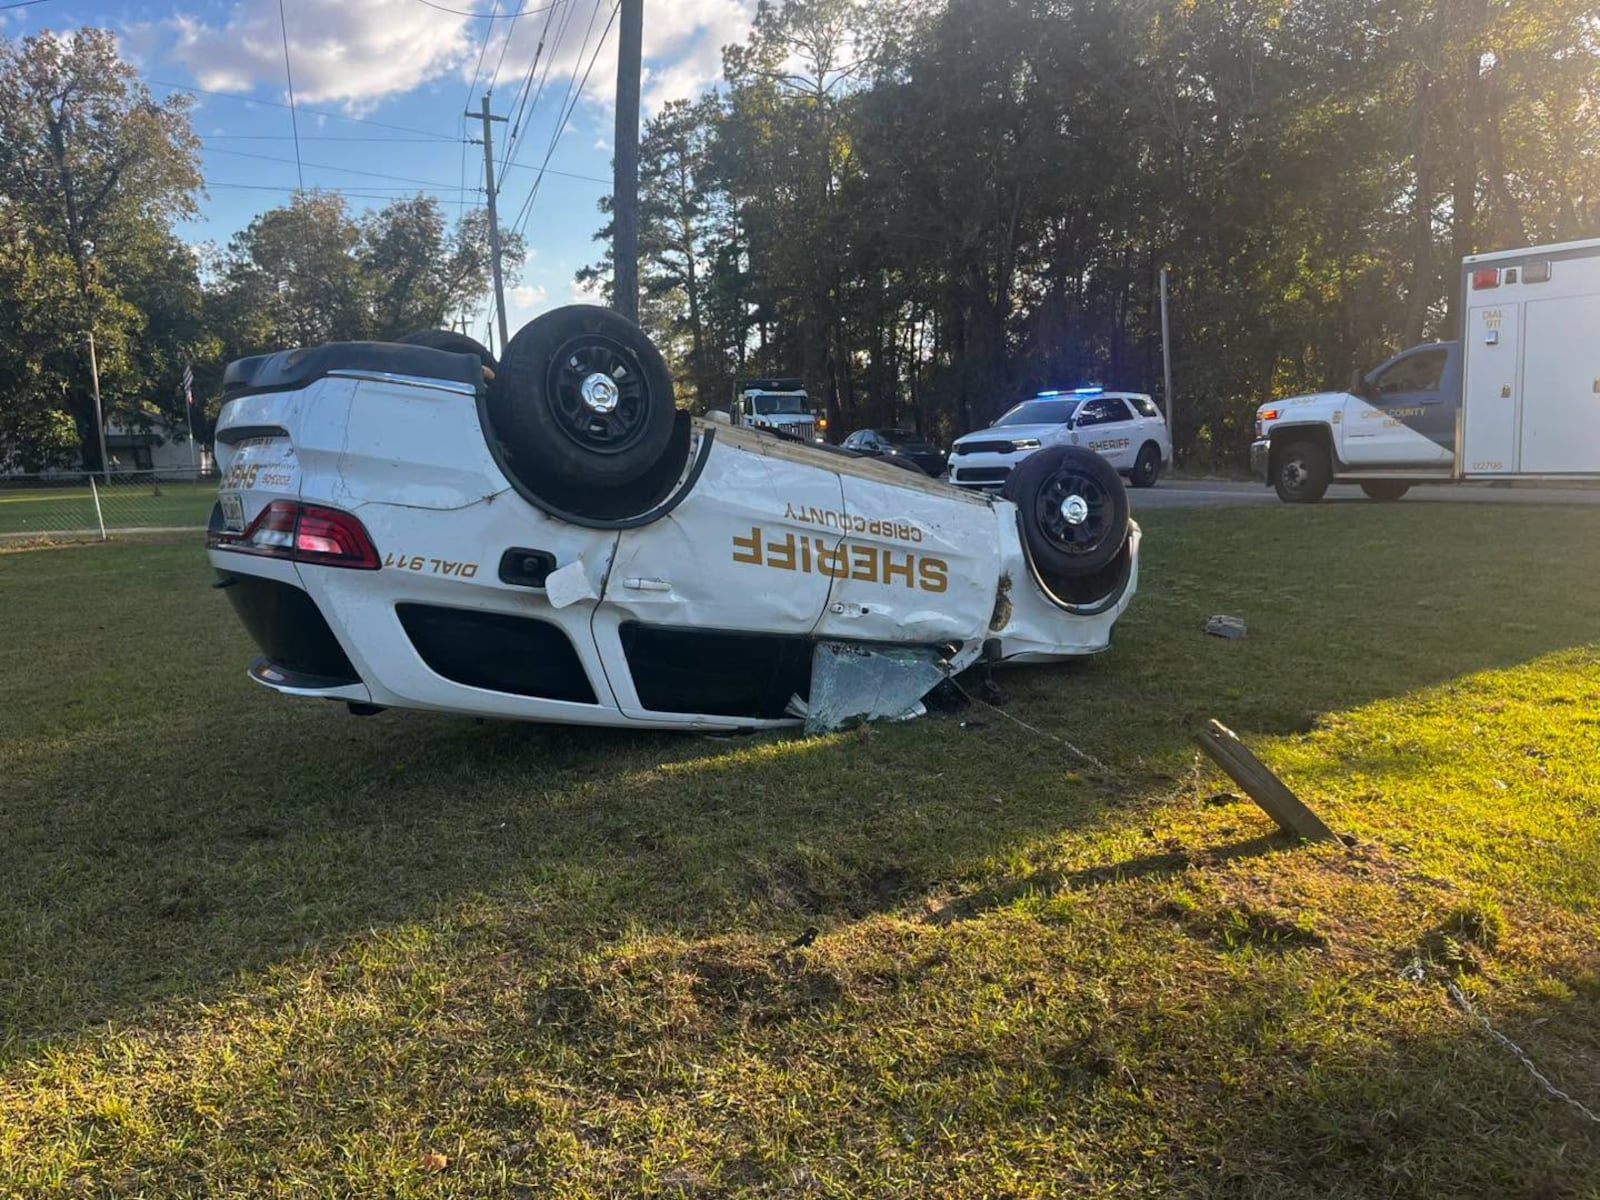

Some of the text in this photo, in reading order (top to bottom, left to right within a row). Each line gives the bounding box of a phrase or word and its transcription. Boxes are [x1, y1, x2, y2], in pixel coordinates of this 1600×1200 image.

[1387, 406, 1427, 417] COUNTY
[1088, 438, 1130, 453] SHERIFF
[784, 502, 923, 544] CRISP COUNTY
[384, 552, 479, 578] DIAL 911
[732, 526, 949, 593] SHERIFF
